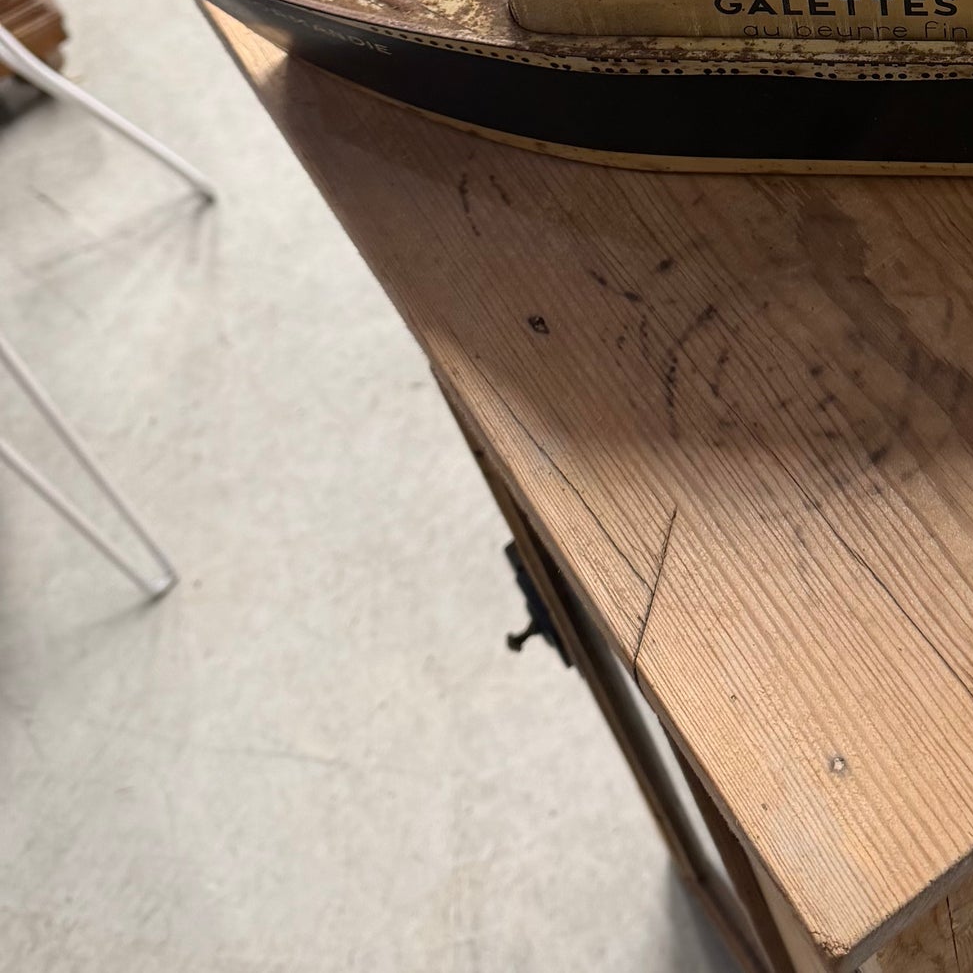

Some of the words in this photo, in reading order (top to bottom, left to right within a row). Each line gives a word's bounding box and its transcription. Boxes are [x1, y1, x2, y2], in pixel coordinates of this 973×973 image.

[743, 25, 780, 38] au
[796, 21, 908, 40] beurre
[924, 20, 968, 40] fin
